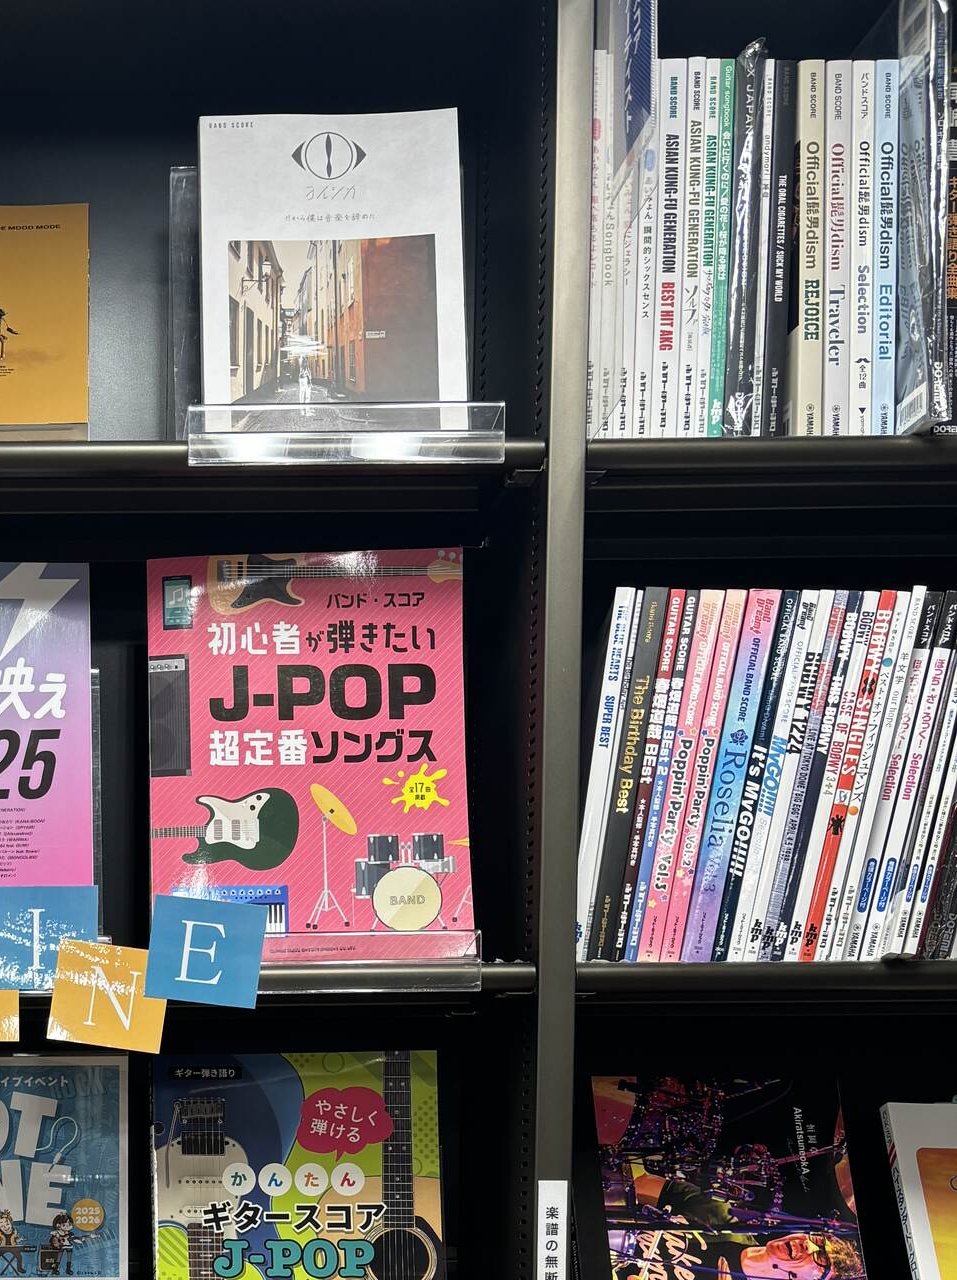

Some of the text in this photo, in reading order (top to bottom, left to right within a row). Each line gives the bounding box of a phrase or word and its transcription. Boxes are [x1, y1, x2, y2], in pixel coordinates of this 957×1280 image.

[884, 72, 892, 93] BAND
[804, 72, 820, 341] BAND SCORE Official髭男dism REJOICE
[878, 141, 894, 270] Official髭男dism
[659, 134, 680, 351] ASIAN KUNG-FU GENERATION BEST HIT AKG
[774, 175, 788, 302] THE ORAL CIGARETTES SUCK MY WORLD
[856, 265, 870, 334] Selection
[827, 284, 847, 366] Traveler
[878, 284, 892, 361] Editorial
[327, 592, 425, 608] バンド・スコア
[207, 619, 437, 656] 初心者が弾きたい
[209, 663, 437, 722] J-POP
[598, 696, 615, 748] SUPER BEST
[615, 675, 650, 814] The Birthday Best
[841, 697, 872, 776] SINGLES
[209, 728, 438, 767] 超定番ソングス
[706, 748, 748, 849] Roselia
[901, 753, 923, 801] Selection
[389, 894, 426, 906] BAND
[174, 1068, 236, 1078] ギター弾き語り
[310, 1118, 361, 1143] 弾ける
[314, 1099, 377, 1126] やさしく
[230, 1170, 357, 1189] かんたん
[75, 1207, 99, 1215] 2025
[75, 1216, 100, 1224] 2026
[201, 1200, 388, 1233] ギタースコア
[211, 1238, 375, 1280] J-POP
